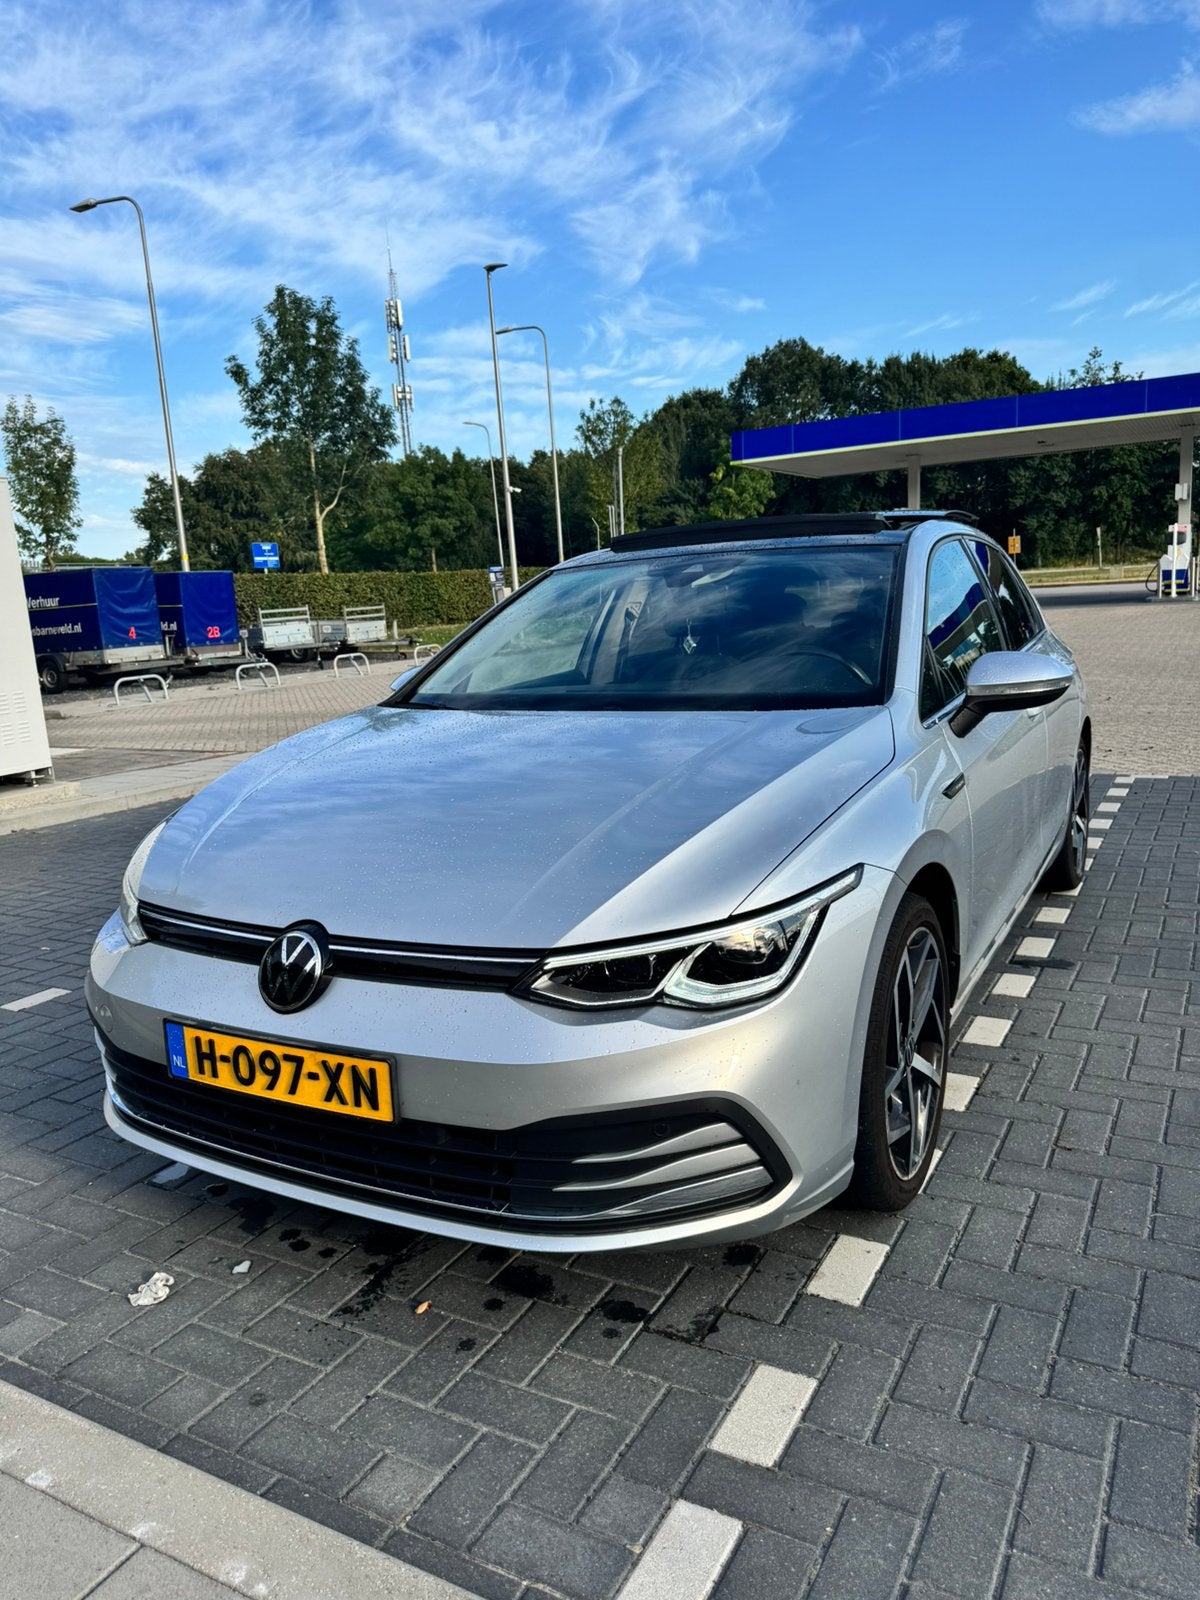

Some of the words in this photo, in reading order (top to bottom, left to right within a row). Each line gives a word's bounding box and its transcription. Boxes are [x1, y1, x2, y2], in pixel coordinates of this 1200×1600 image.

[128, 626, 136, 639] 4
[172, 1054, 186, 1069] NL
[194, 1035, 380, 1111] H-097-XN
